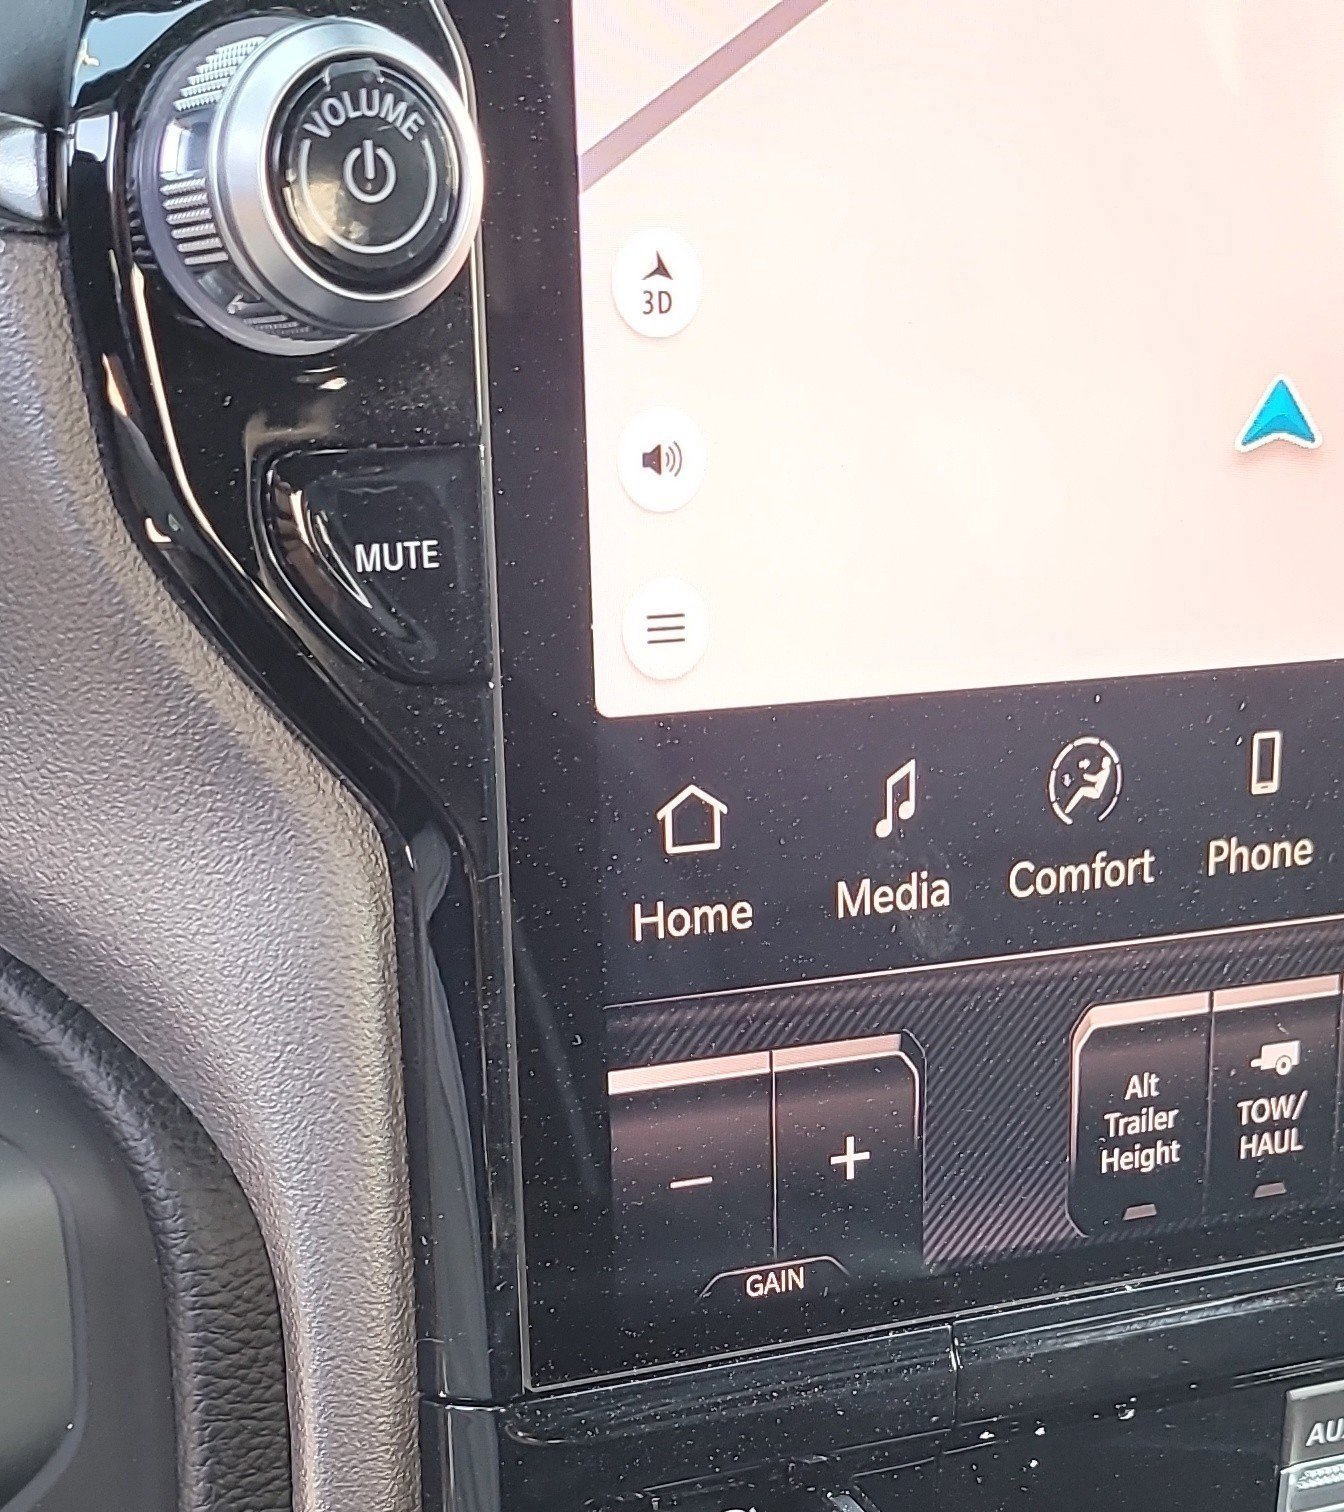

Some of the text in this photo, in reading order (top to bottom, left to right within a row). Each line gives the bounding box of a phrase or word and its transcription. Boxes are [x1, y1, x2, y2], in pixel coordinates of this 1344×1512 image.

[302, 88, 425, 141] VOLUME
[642, 290, 672, 315] 3D
[355, 540, 440, 573] MUTE
[1009, 848, 1155, 899] Comfort
[1208, 837, 1314, 876] Phone
[837, 870, 950, 918] Media
[634, 901, 753, 941] Home
[1125, 1073, 1160, 1101] Alt
[1105, 1107, 1179, 1138] Trailer
[1238, 1091, 1307, 1126] TOW/
[1101, 1139, 1181, 1176] Height
[1239, 1129, 1304, 1160] HAUL
[746, 1266, 805, 1297] GAIN
